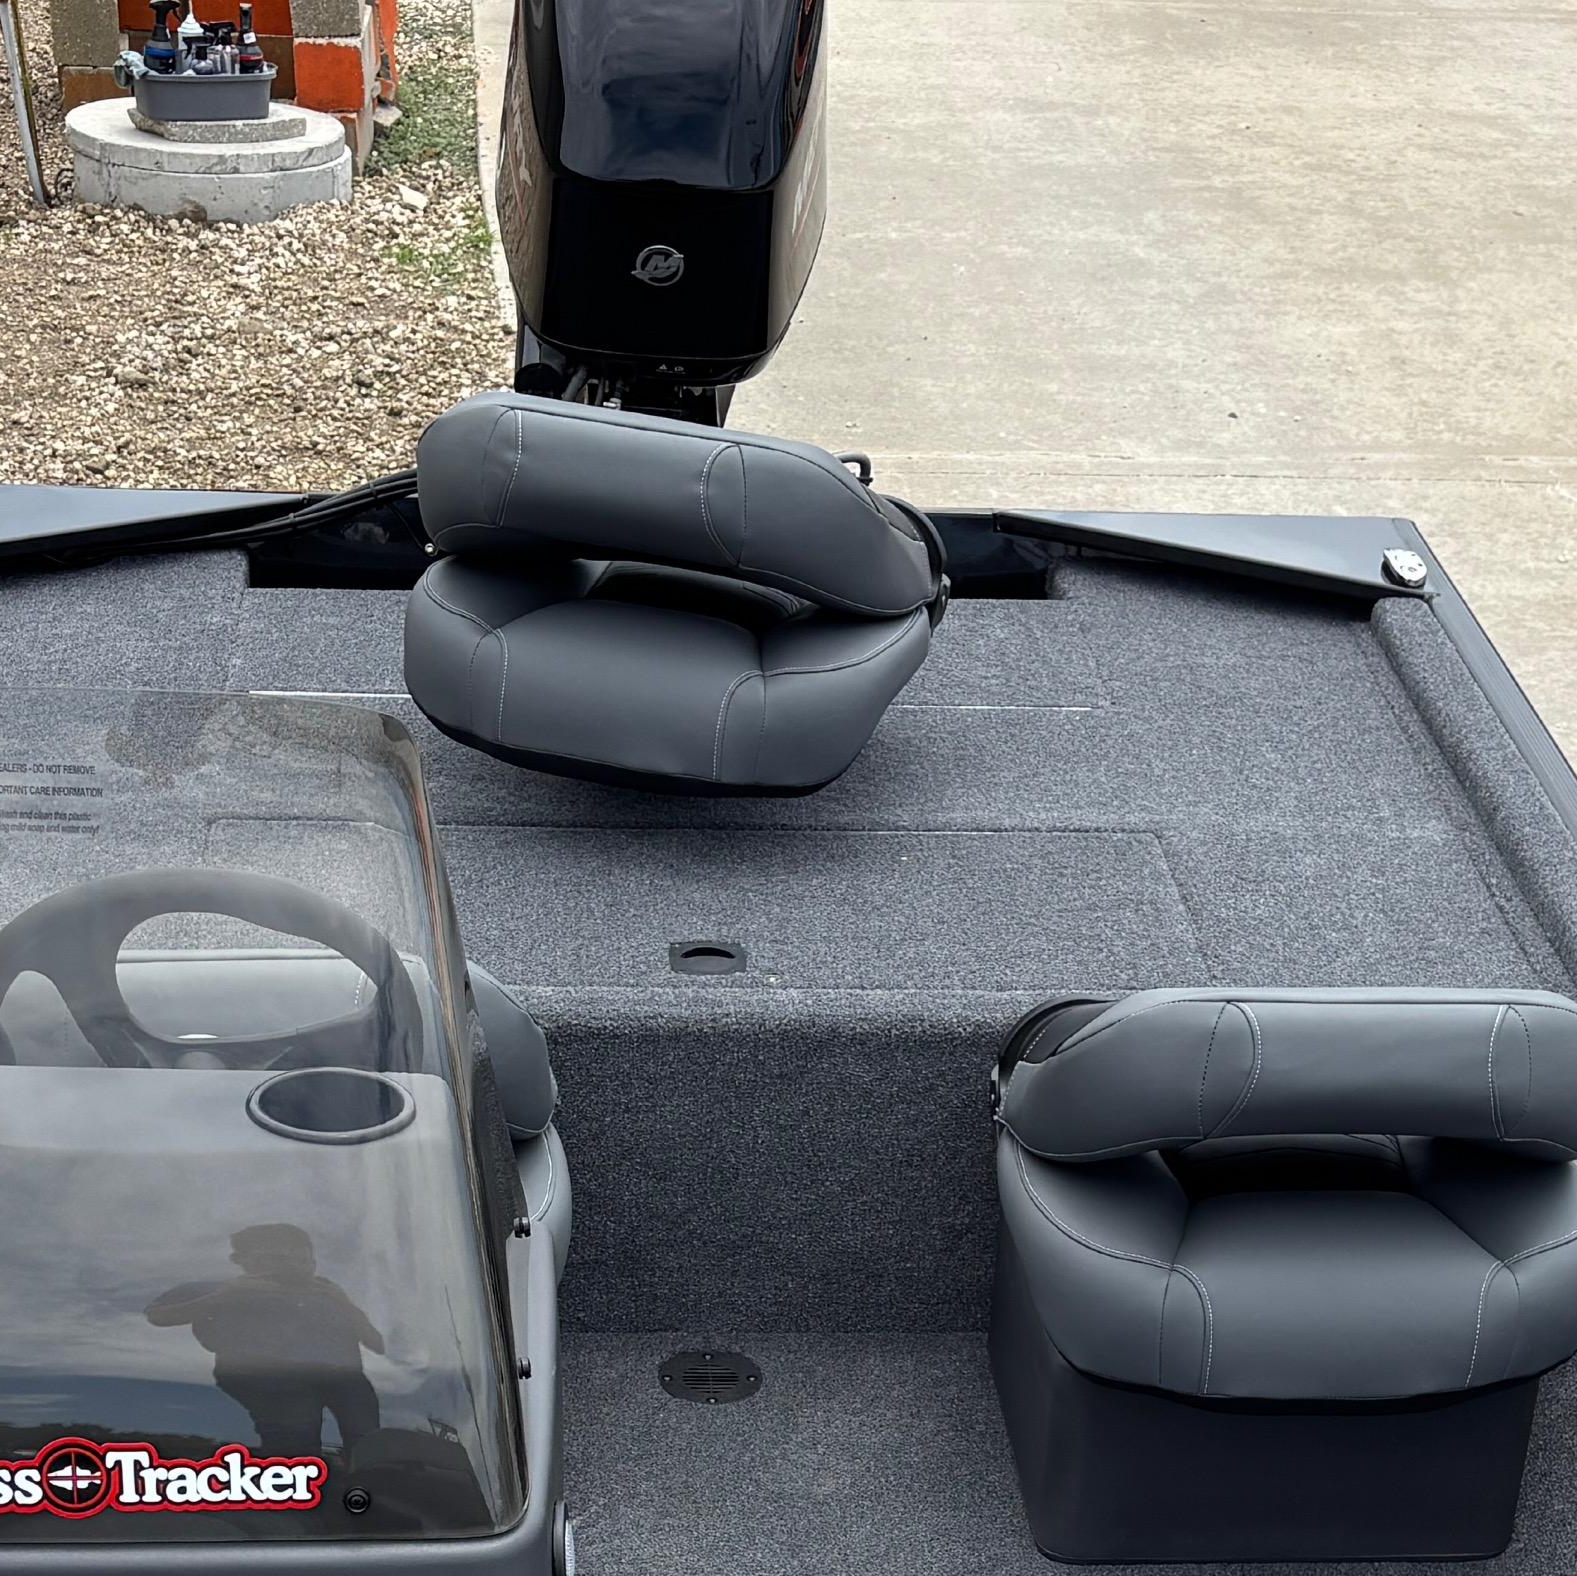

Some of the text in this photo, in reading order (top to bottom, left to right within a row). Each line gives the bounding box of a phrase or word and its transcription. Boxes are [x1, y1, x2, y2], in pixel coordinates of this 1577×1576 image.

[32, 763, 44, 774] DO
[46, 765, 62, 775] NOT
[63, 765, 96, 775] REMOVE
[29, 785, 51, 796] CARE
[52, 787, 104, 798] INFORMATION
[19, 809, 32, 820] and
[33, 810, 53, 821] clean
[54, 811, 67, 821] this
[68, 811, 91, 822] plastic
[10, 822, 26, 832] mild
[27, 824, 44, 834] soap
[45, 823, 60, 833] and
[105, 1449, 319, 1504] Tracker
